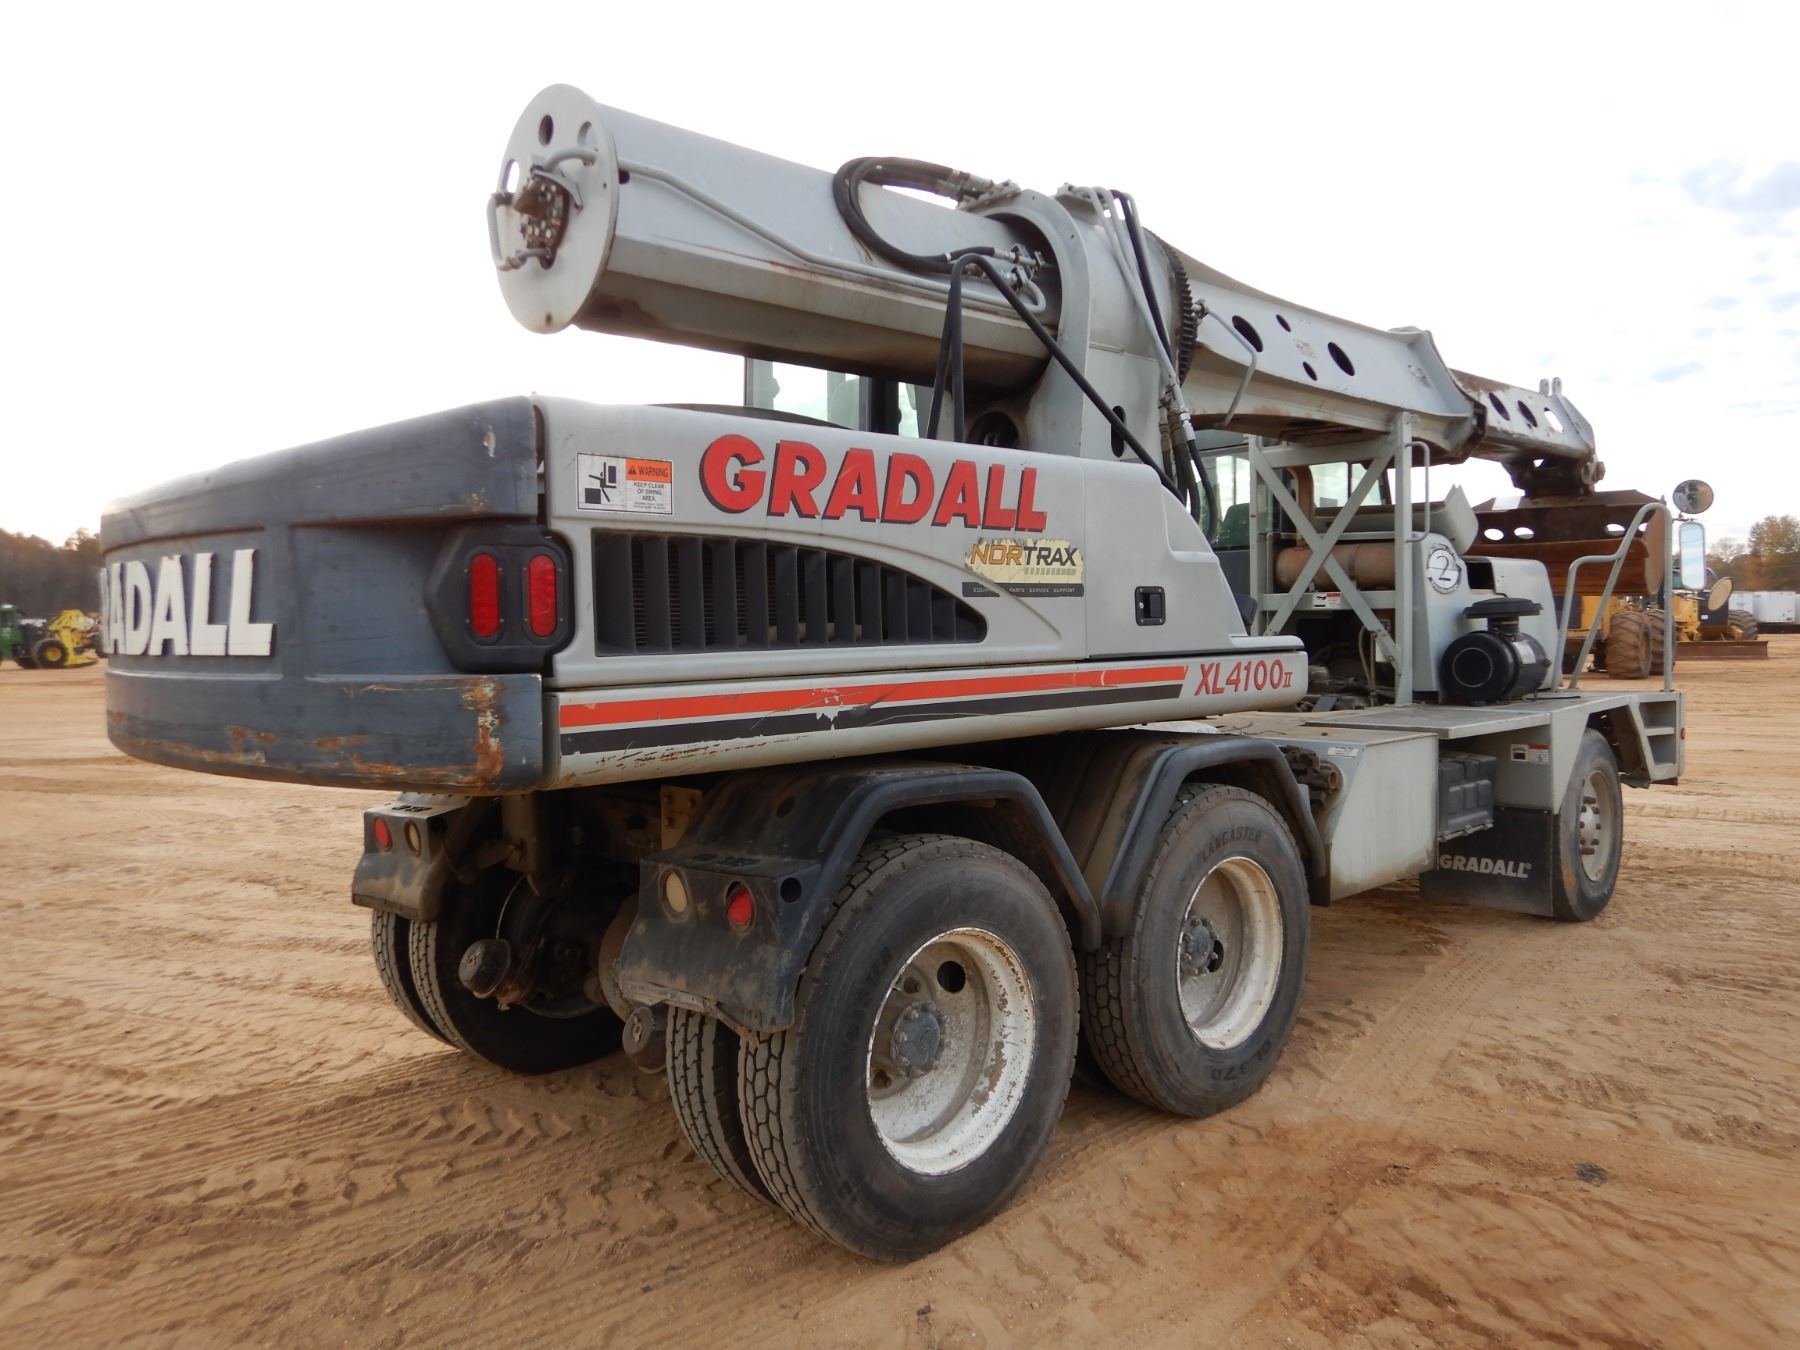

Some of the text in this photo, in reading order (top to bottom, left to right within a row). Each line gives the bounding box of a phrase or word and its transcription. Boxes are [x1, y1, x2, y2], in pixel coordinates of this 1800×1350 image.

[638, 465, 669, 478] WARNING
[699, 434, 1048, 533] GRADALL
[970, 544, 1077, 566] NORTRAX
[1202, 826, 1261, 862] LANCASTER
